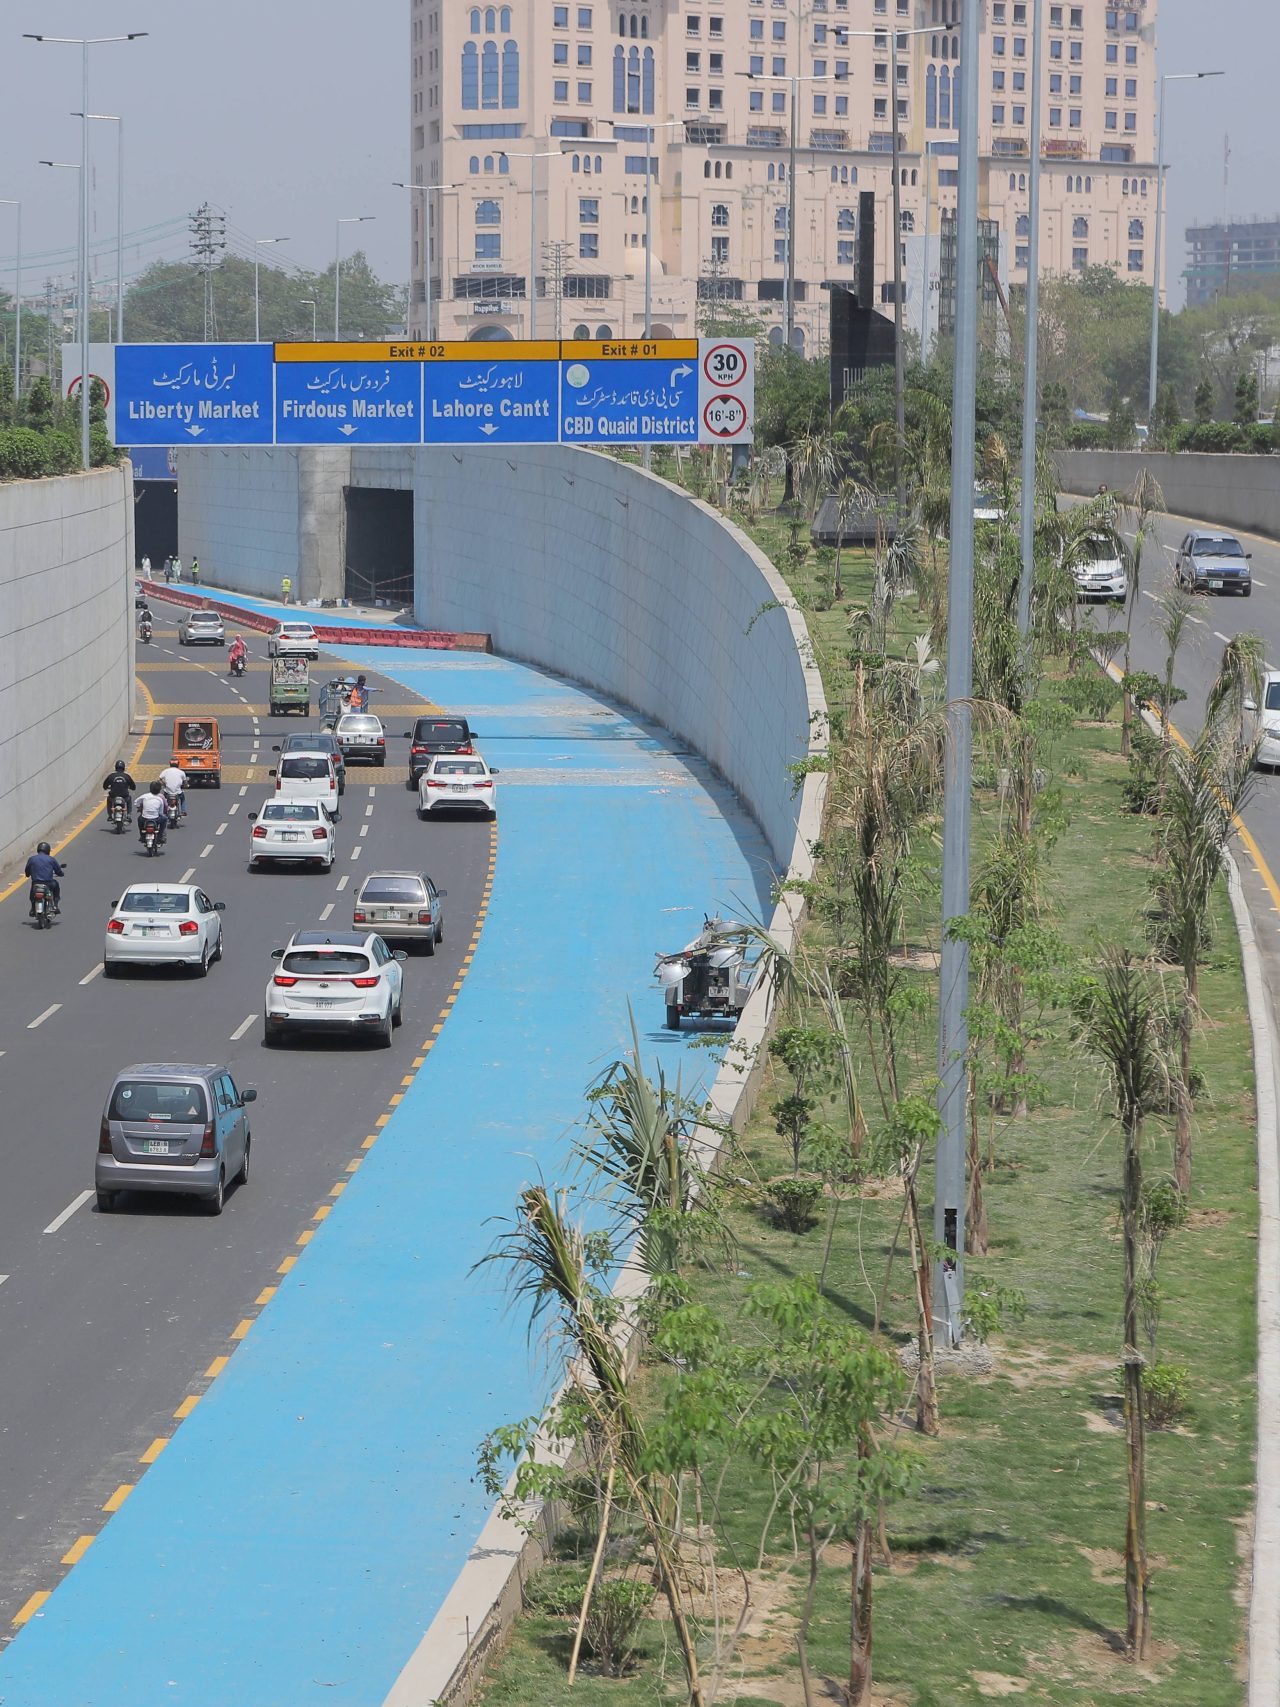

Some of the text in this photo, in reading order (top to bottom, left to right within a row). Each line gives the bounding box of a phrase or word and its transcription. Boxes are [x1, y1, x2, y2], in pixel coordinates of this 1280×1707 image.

[389, 345, 445, 357] Exit # 02
[601, 344, 657, 356] Exit # 01
[713, 353, 738, 371] 30
[152, 356, 237, 391] لبرٹی مارکیٹ
[306, 367, 390, 394] فردوس مارکیٹ
[717, 373, 733, 381] KPH
[129, 400, 260, 423] Liberty Market
[282, 399, 414, 418] Firdous Market
[432, 398, 550, 417] Lahore Cantt
[564, 415, 695, 436] CBD Quaid District
